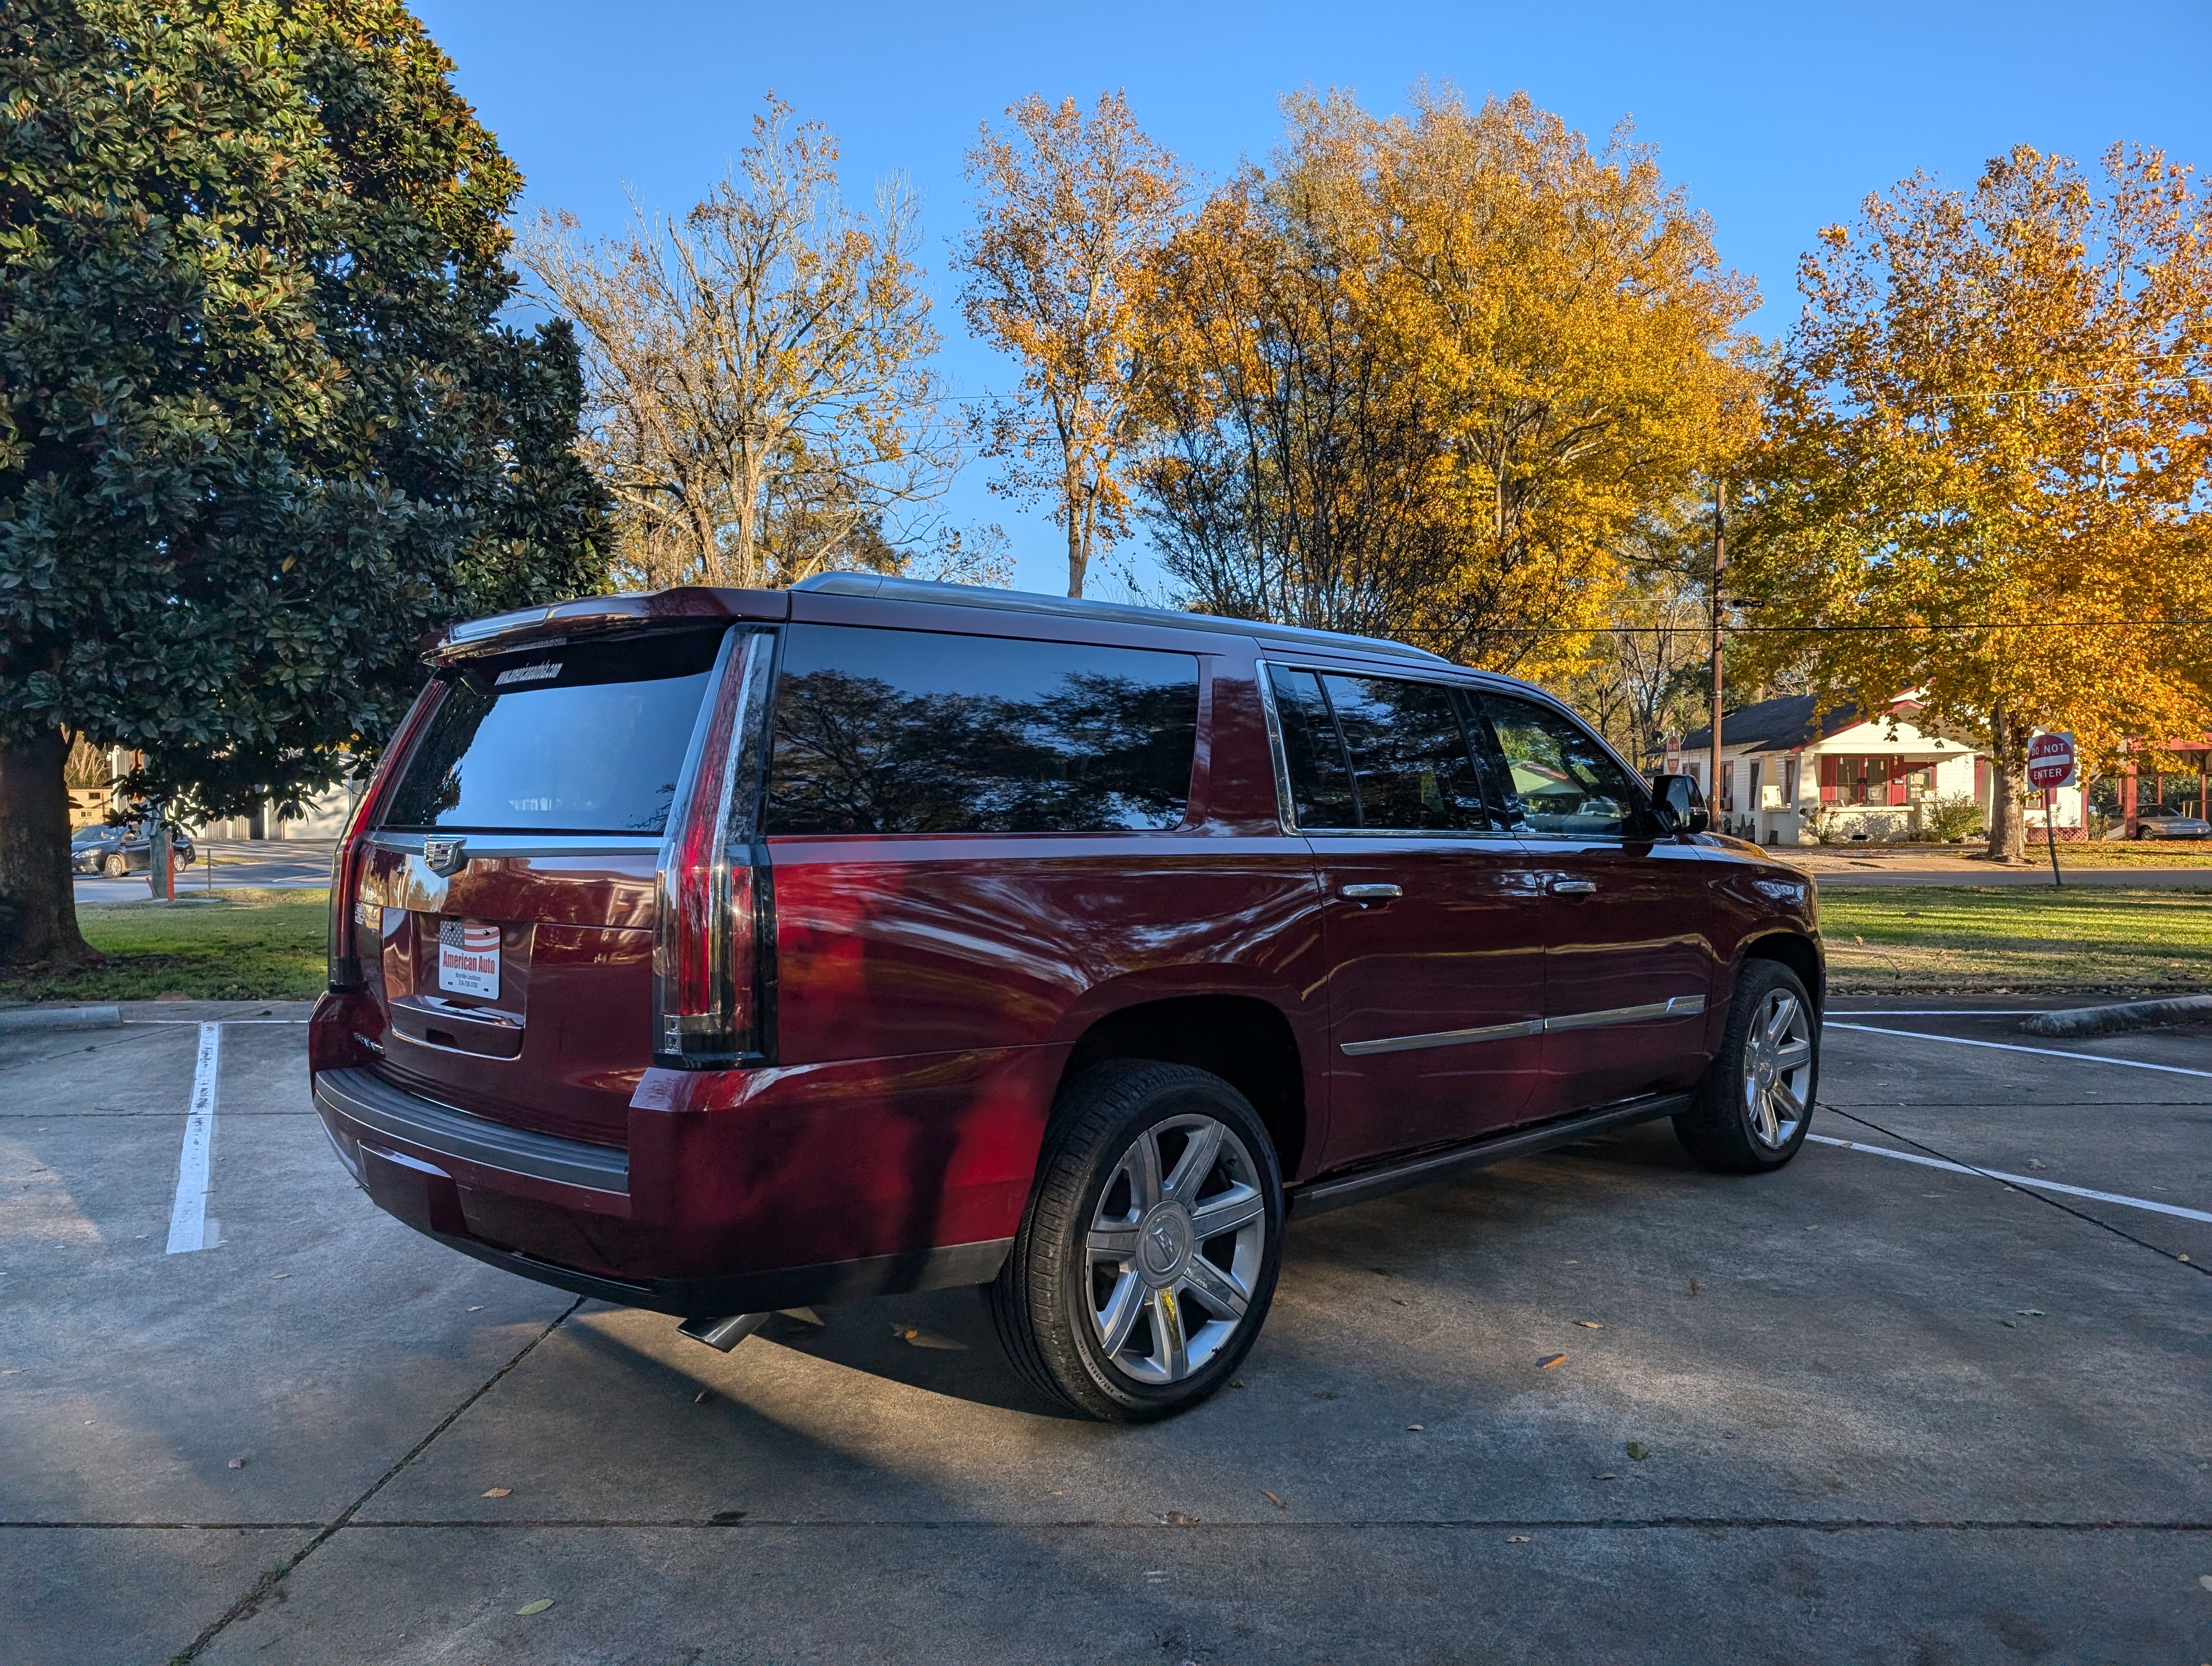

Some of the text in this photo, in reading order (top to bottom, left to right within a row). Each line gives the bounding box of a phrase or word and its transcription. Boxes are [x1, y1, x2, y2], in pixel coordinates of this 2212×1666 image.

[2032, 743, 2065, 756] DO NOT
[2034, 768, 2062, 780] ENTER
[443, 950, 496, 975] American Auto
